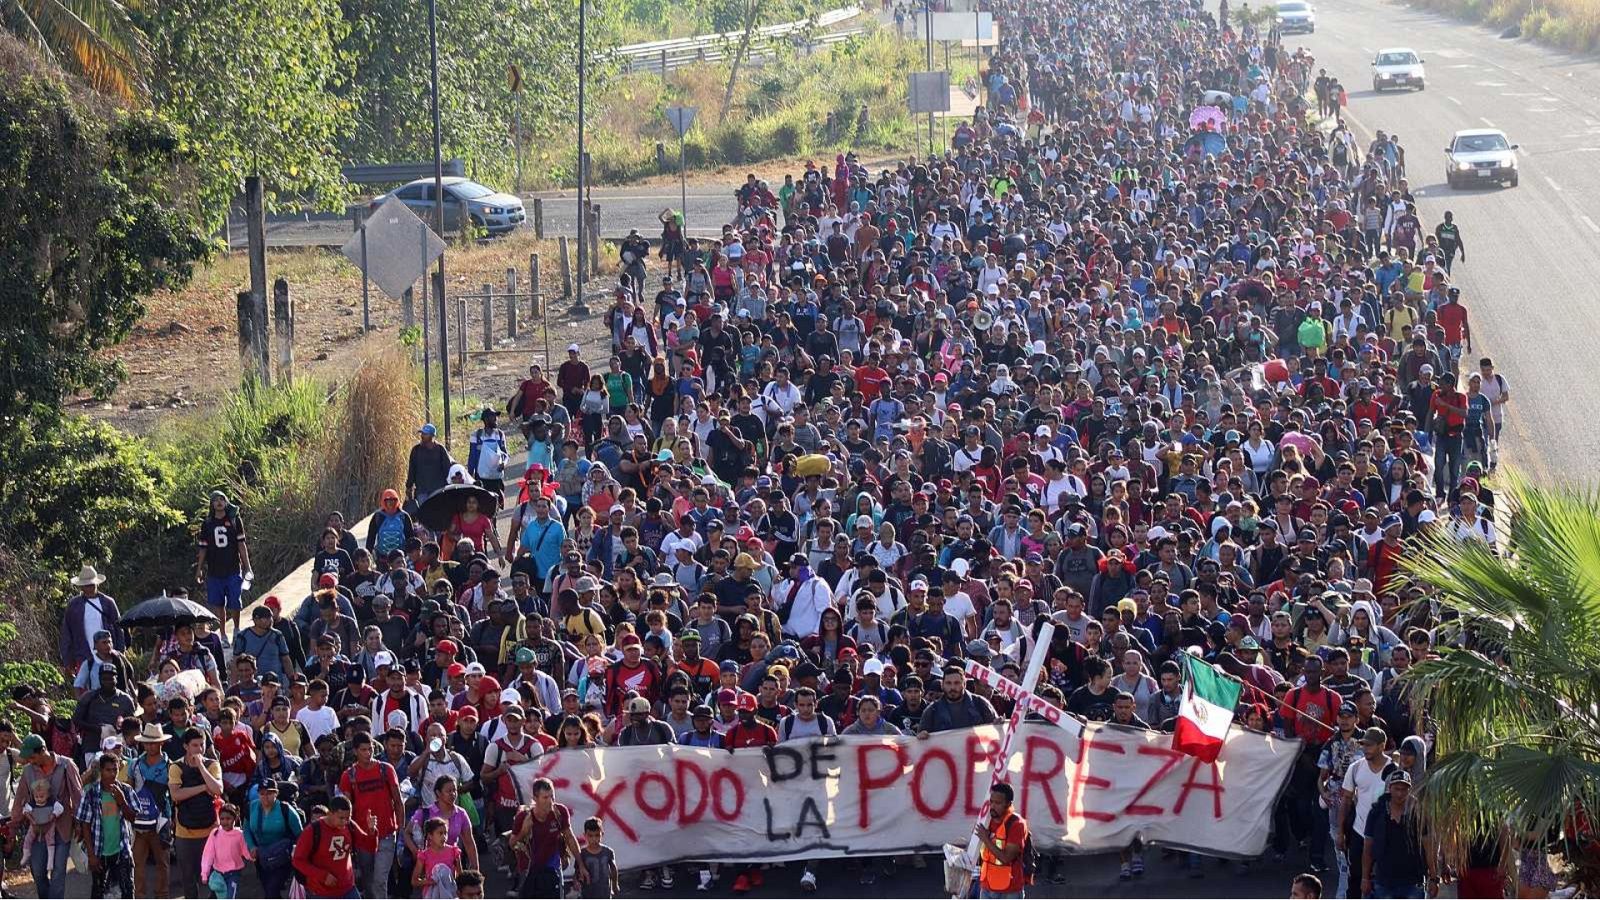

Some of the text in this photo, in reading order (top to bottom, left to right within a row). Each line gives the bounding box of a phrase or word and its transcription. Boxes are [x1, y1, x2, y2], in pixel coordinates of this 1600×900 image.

[214, 526, 228, 548] 6
[765, 738, 841, 783] DE
[855, 731, 1226, 830] POBREZA
[763, 796, 831, 842] LA
